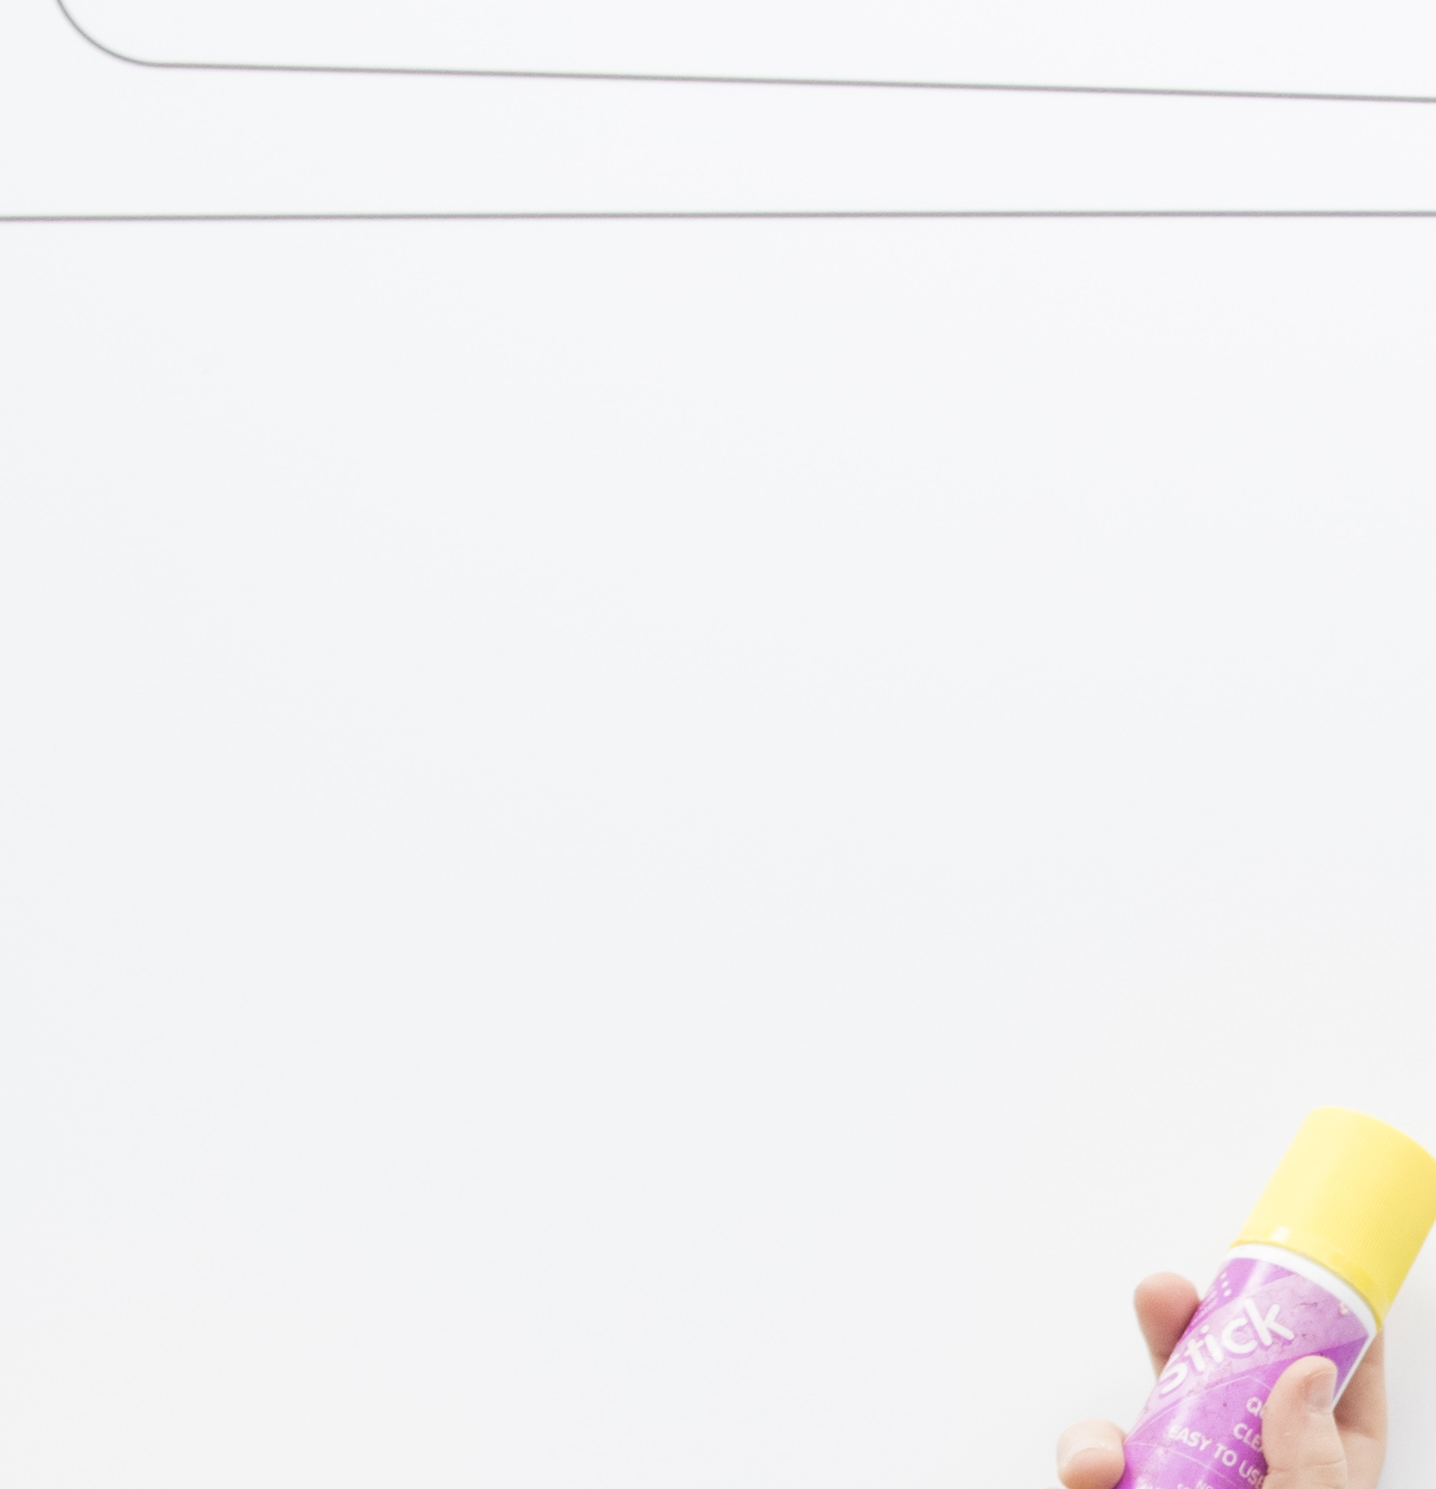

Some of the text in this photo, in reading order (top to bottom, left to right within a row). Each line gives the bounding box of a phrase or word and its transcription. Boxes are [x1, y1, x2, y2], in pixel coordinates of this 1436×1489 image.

[1168, 1424, 1212, 1451] EASY
[1214, 1442, 1238, 1467] TO
[1233, 1423, 1263, 1451] CLE
